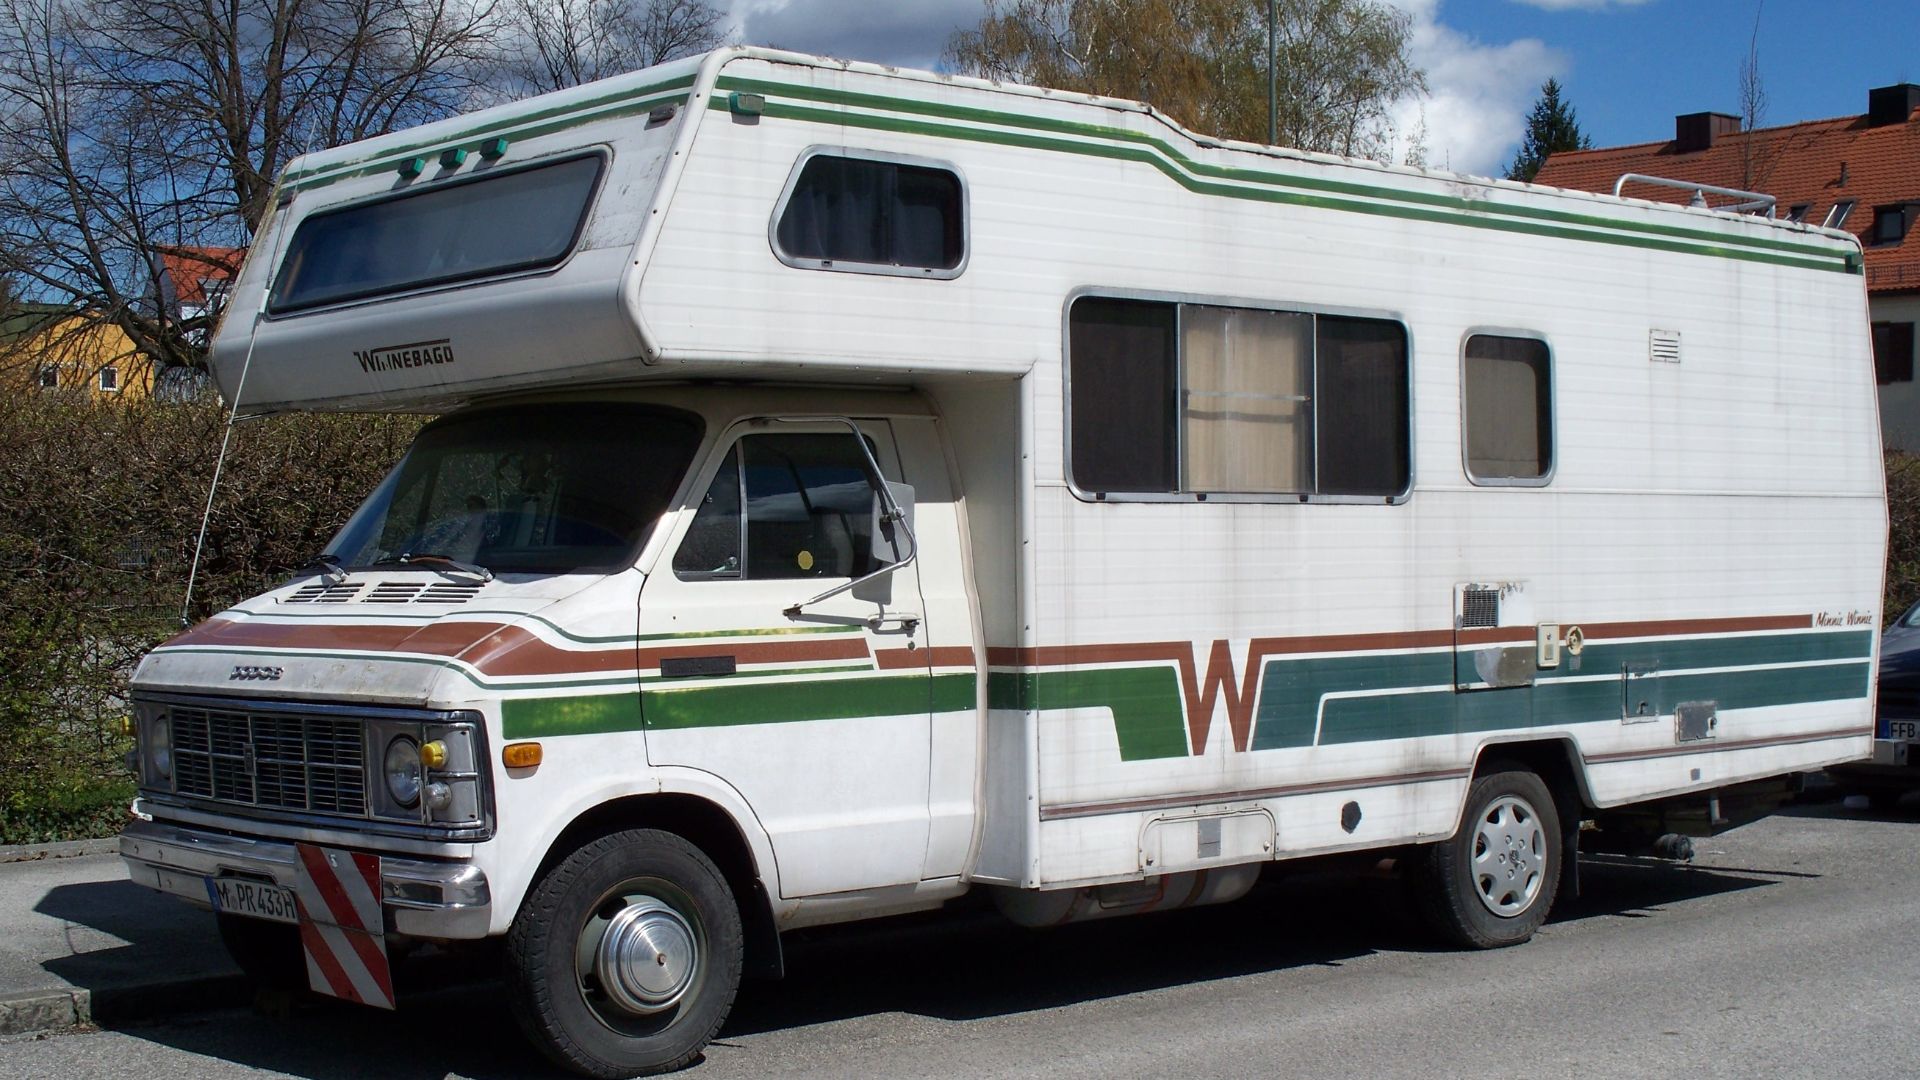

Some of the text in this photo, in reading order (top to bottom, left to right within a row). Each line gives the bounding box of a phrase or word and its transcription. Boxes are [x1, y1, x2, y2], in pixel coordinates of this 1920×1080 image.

[229, 665, 284, 681] DODGE
[1890, 722, 1916, 738] FFB
[215, 882, 296, 919] M PR 433H
